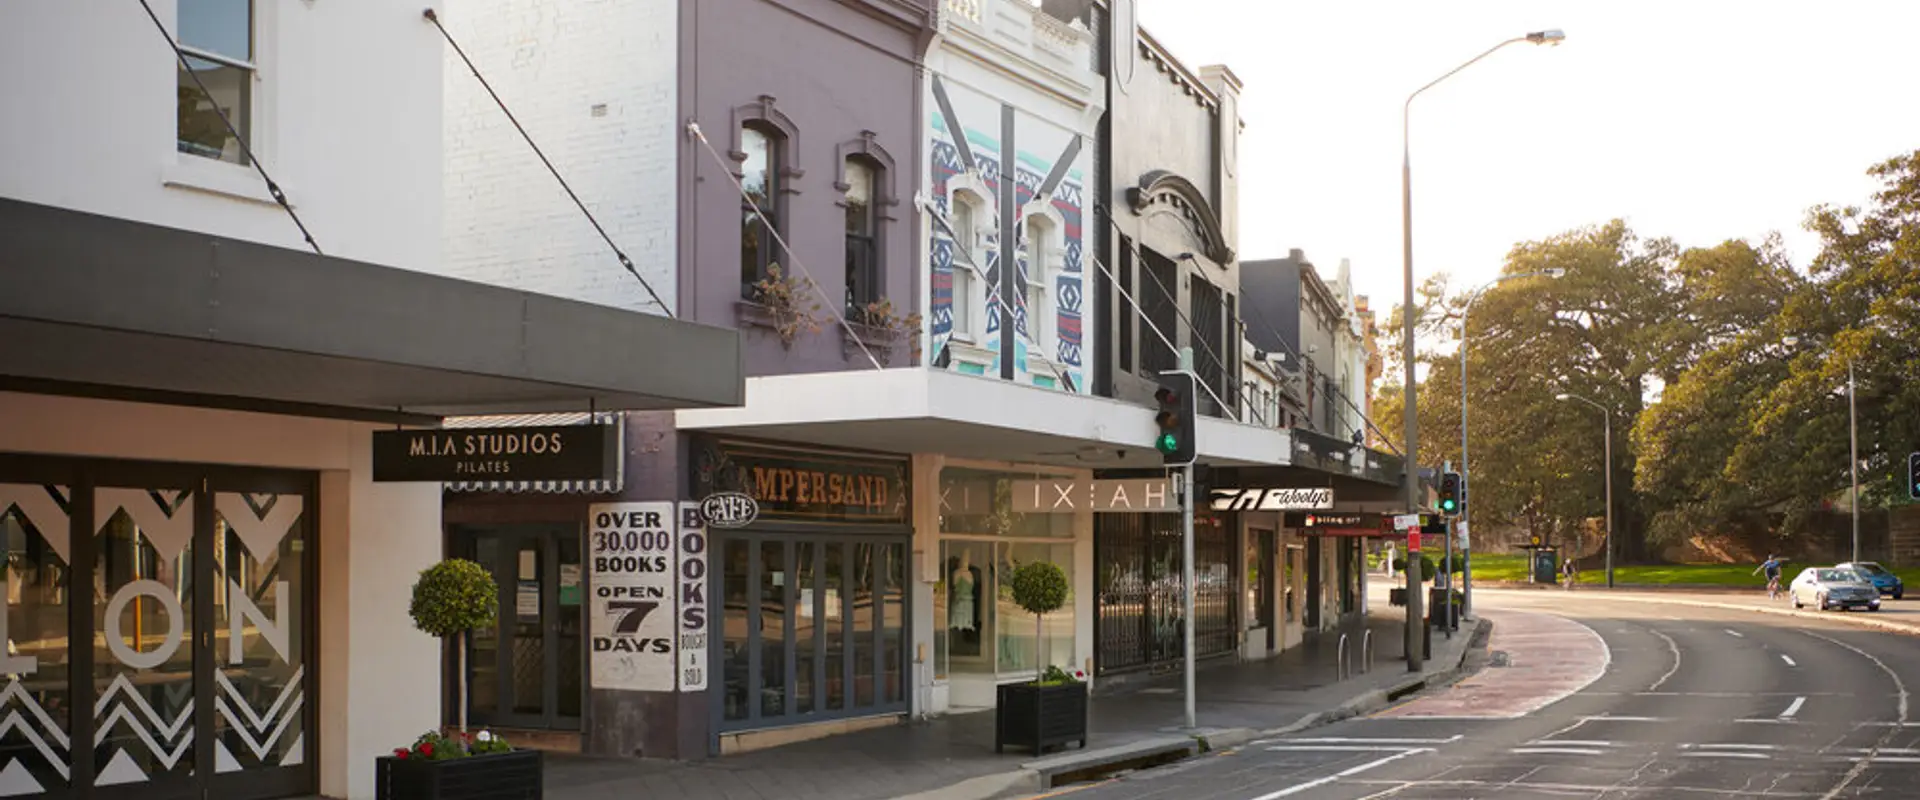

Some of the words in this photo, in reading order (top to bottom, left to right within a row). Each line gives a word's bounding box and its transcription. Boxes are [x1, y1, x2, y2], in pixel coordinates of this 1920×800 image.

[464, 432, 563, 456] STUDIOS
[456, 460, 511, 474] PILATES
[704, 495, 752, 523] CAFE
[596, 511, 662, 528] OVER
[593, 530, 670, 554] 30,000
[594, 556, 667, 573] BOOKS
[682, 507, 705, 631] BOOKS
[596, 586, 664, 599] OPEN
[605, 601, 660, 637] 7
[593, 637, 671, 654] DAYS
